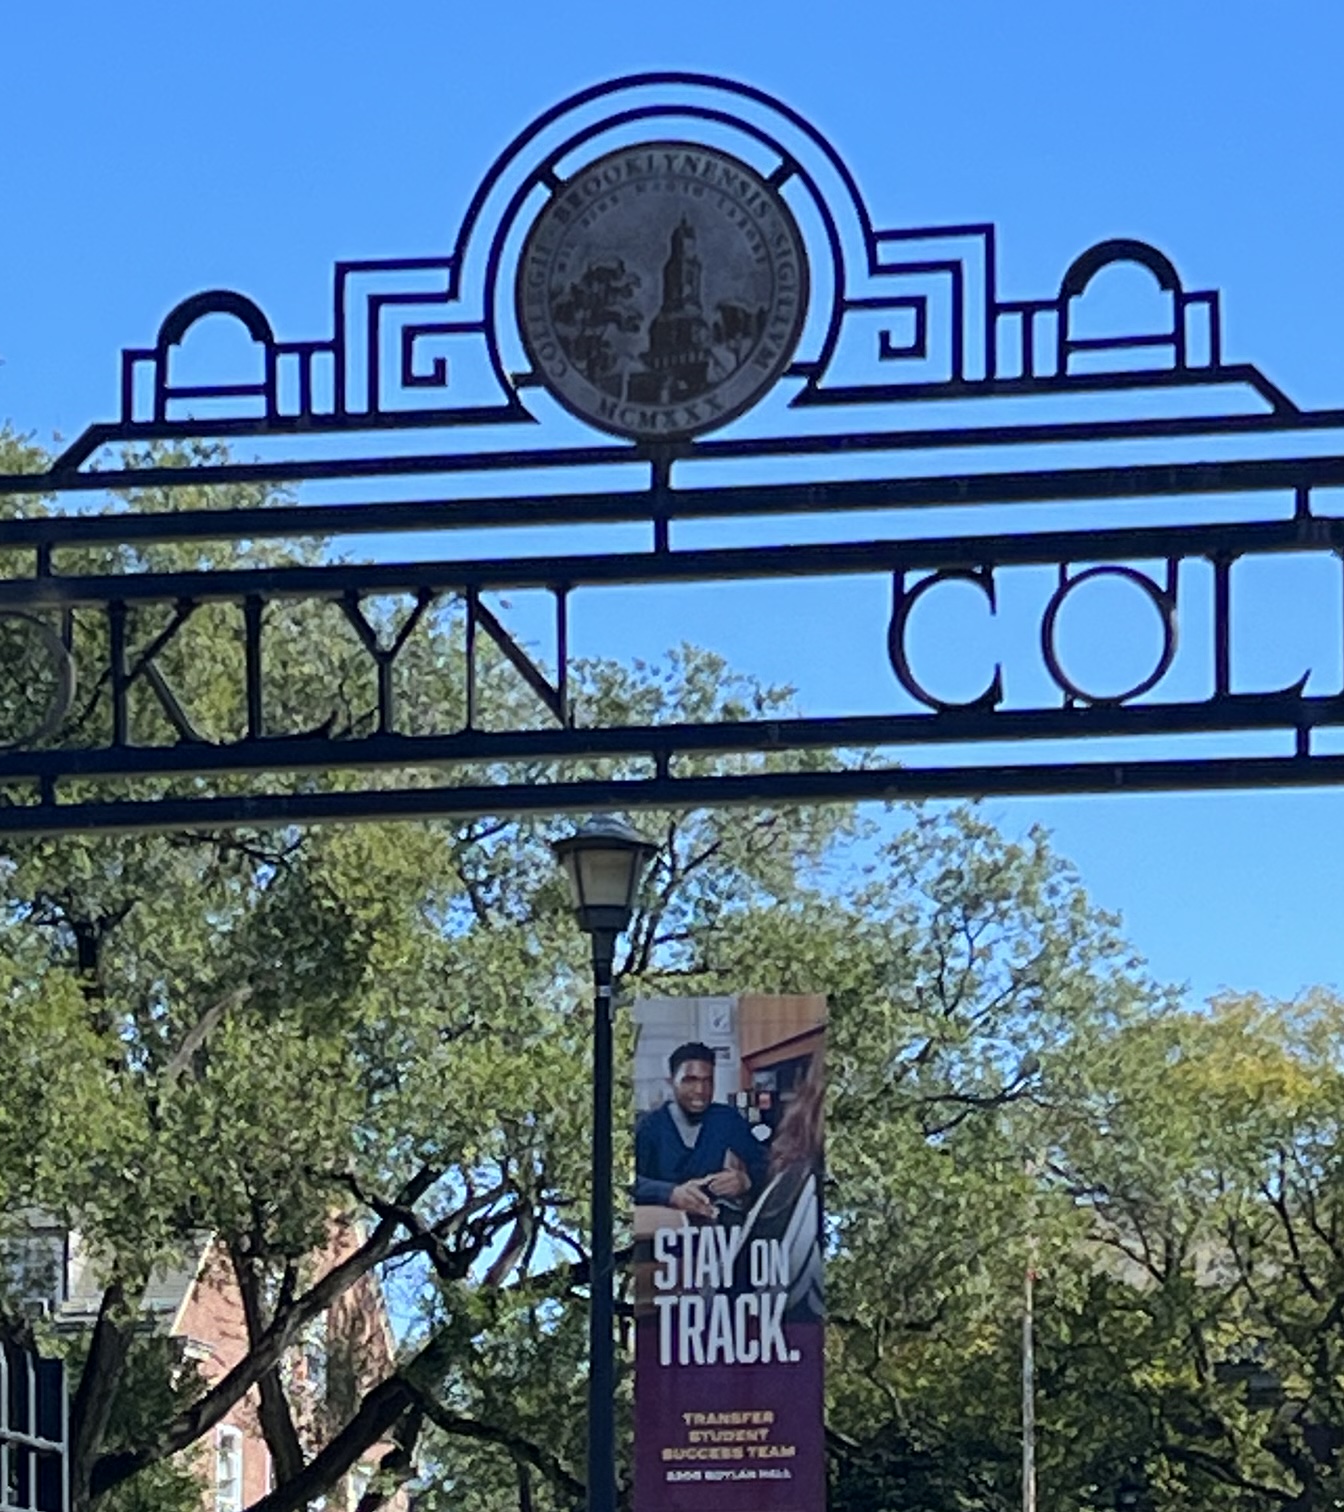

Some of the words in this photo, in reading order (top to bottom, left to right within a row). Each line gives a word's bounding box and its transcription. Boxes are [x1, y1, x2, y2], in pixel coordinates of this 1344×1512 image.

[654, 1226, 740, 1289] STAY
[751, 1239, 789, 1286] ON
[653, 1292, 801, 1365] TRACK.
[682, 1411, 775, 1426] TRANSFER
[687, 1428, 770, 1443] STUDENT
[661, 1446, 744, 1461] SUCCESS
[746, 1445, 796, 1459] TEAM
